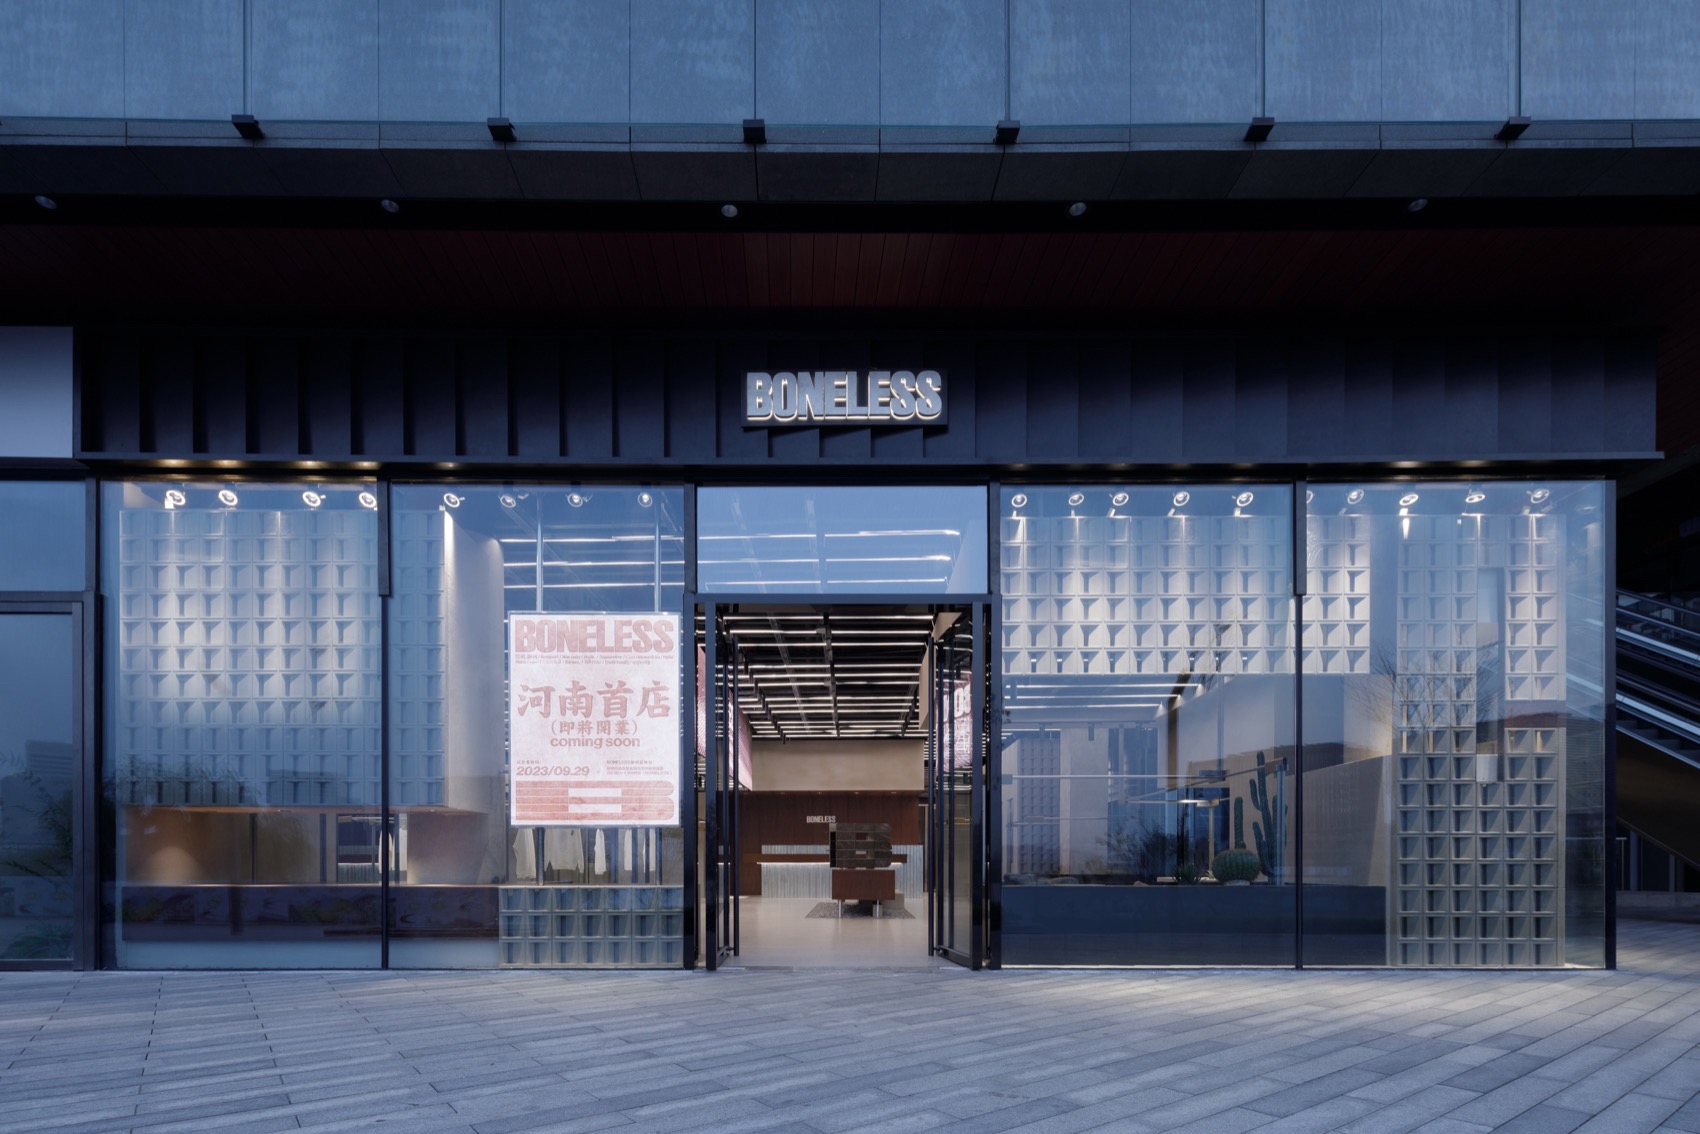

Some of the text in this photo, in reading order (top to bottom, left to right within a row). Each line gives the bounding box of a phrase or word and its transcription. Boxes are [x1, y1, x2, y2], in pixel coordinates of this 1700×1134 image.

[746, 370, 942, 421] BONELESS
[515, 619, 674, 653] BONELESS
[517, 680, 671, 719] 河南首店
[550, 735, 641, 749] coming soon
[516, 765, 590, 776] 2023/09.29
[806, 815, 837, 823] BONELESS
